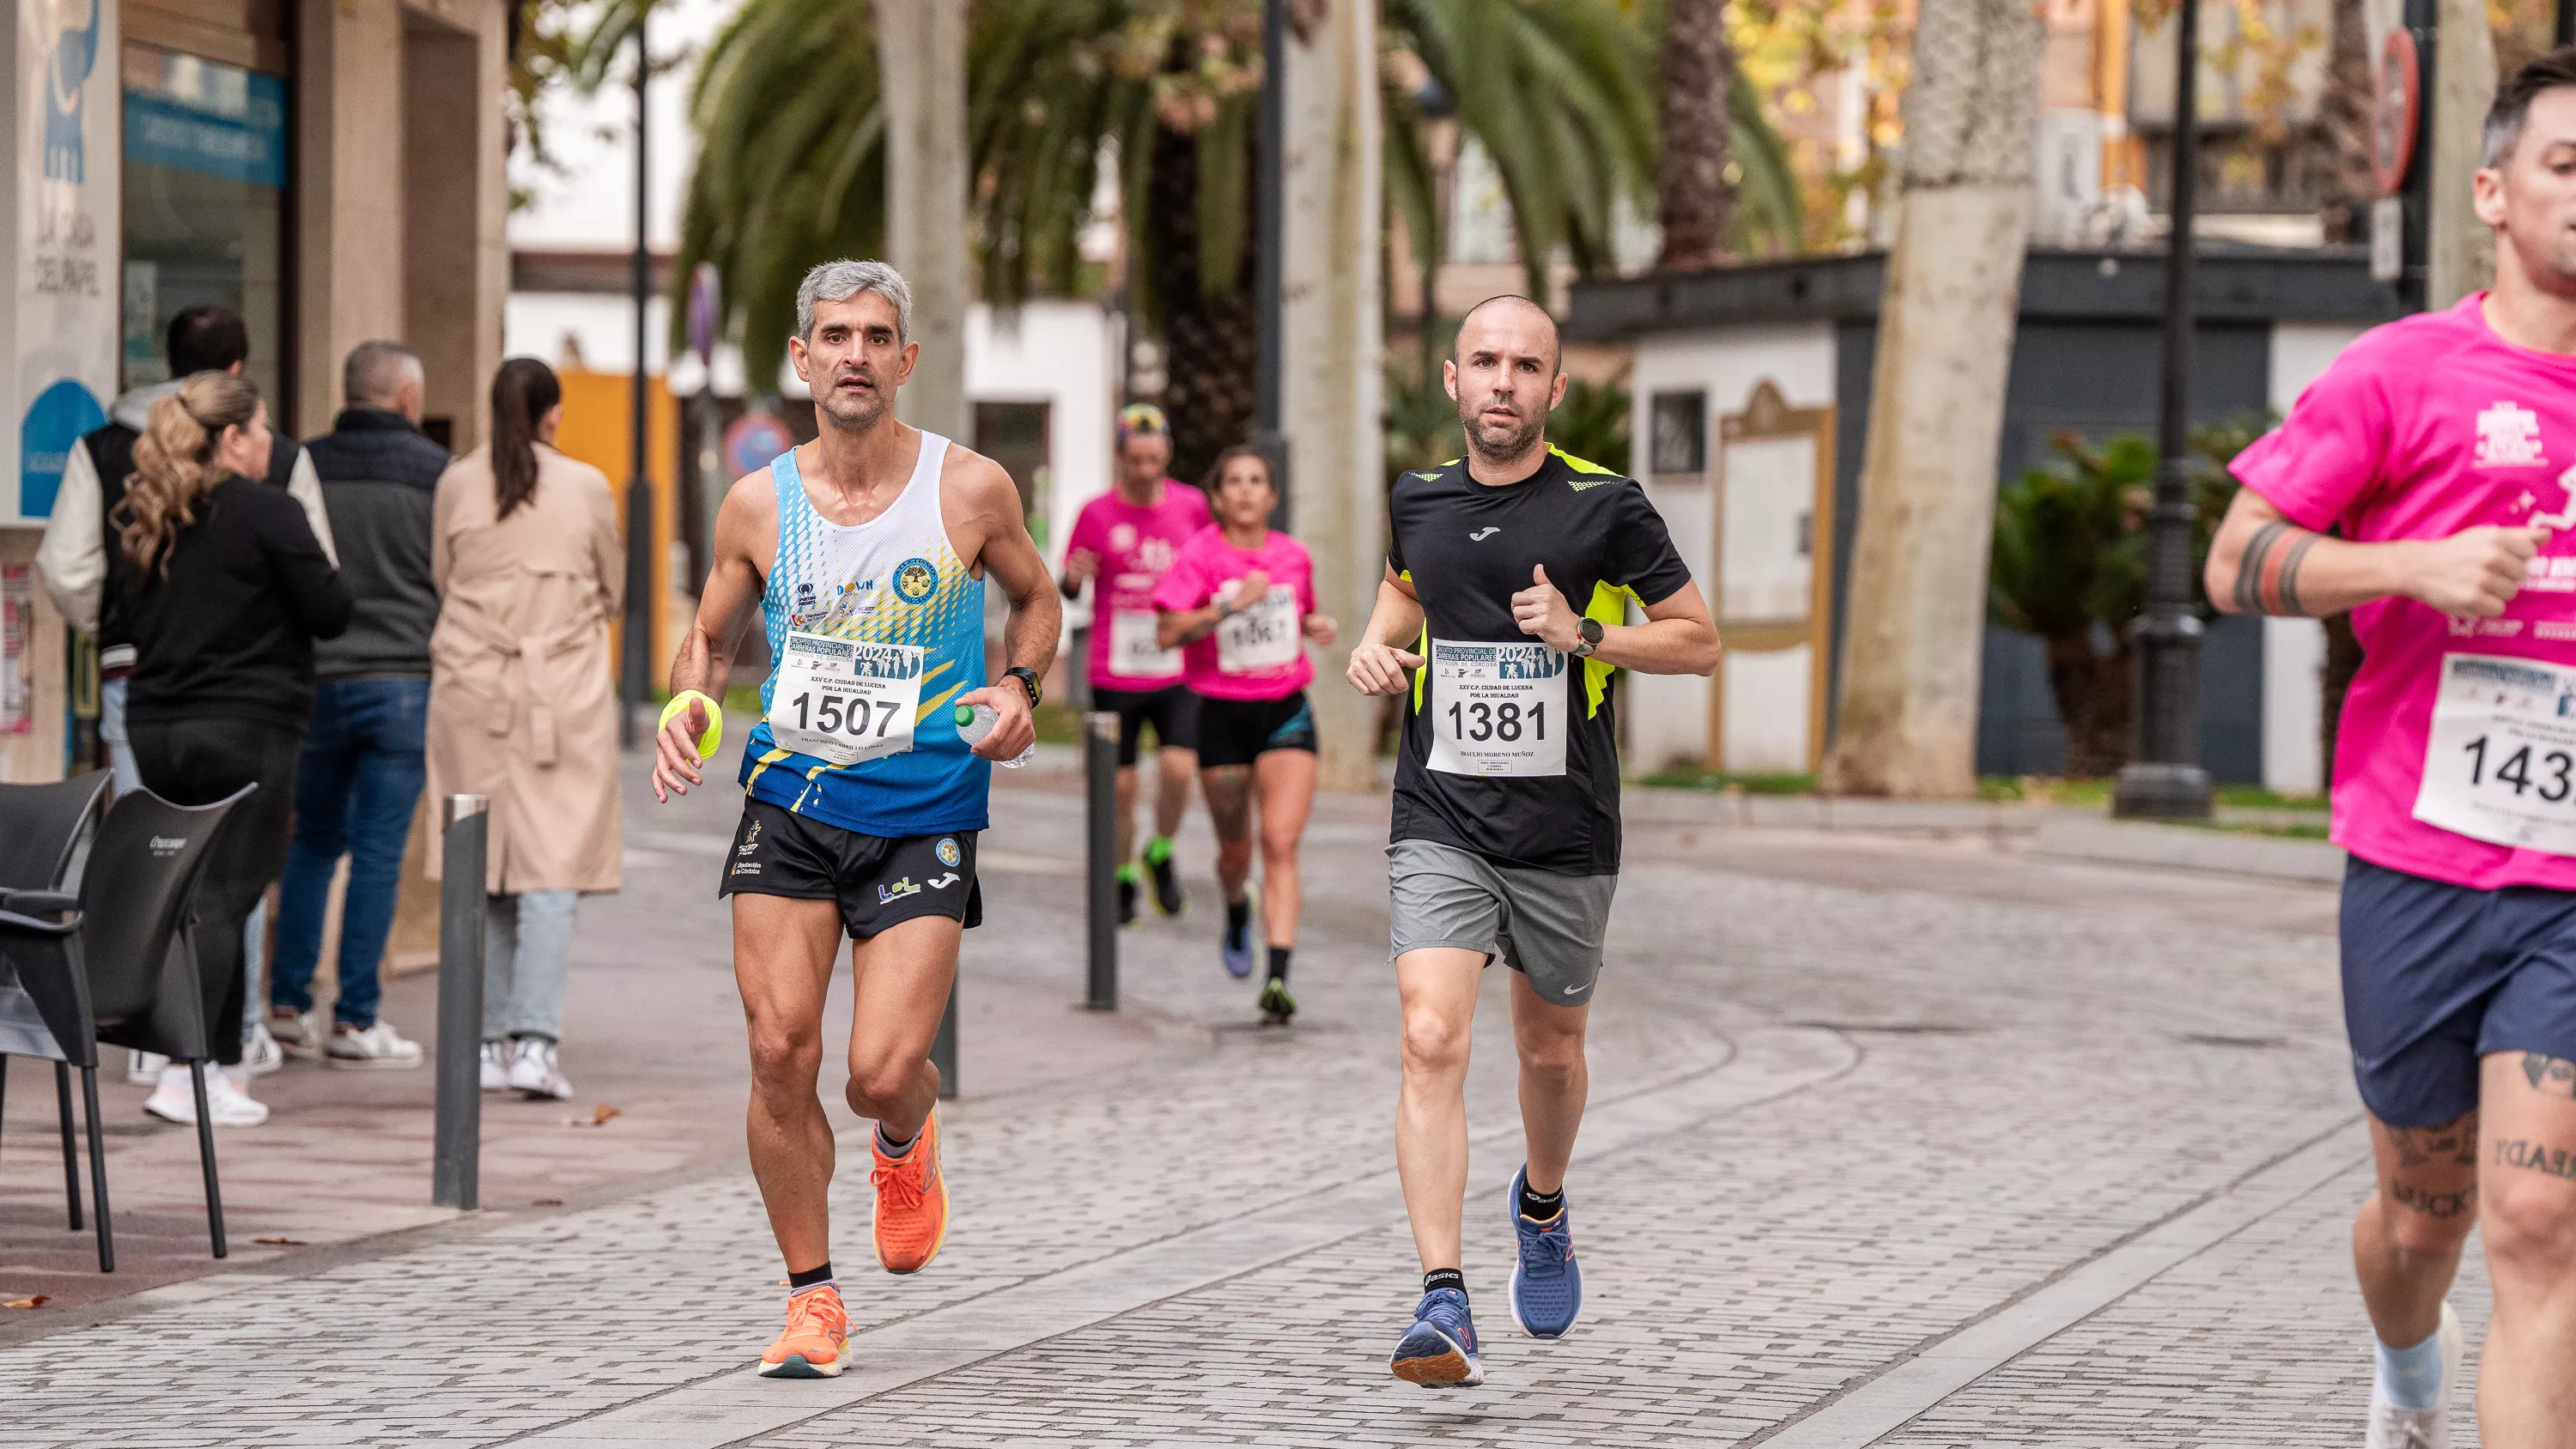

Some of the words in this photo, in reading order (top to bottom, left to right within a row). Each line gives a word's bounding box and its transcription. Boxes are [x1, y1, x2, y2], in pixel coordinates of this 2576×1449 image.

[789, 642, 816, 653] CARRERAS
[817, 646, 854, 658] POPULARES
[811, 640, 845, 651] PROVINCIAL
[855, 646, 893, 662] 2024
[1498, 646, 1536, 662] 2024
[793, 692, 901, 737] 1507
[1449, 701, 1545, 742] 1381
[801, 737, 834, 746] FRANCISCO
[835, 742, 864, 750] CARRILLO
[2464, 733, 2576, 803] 143
